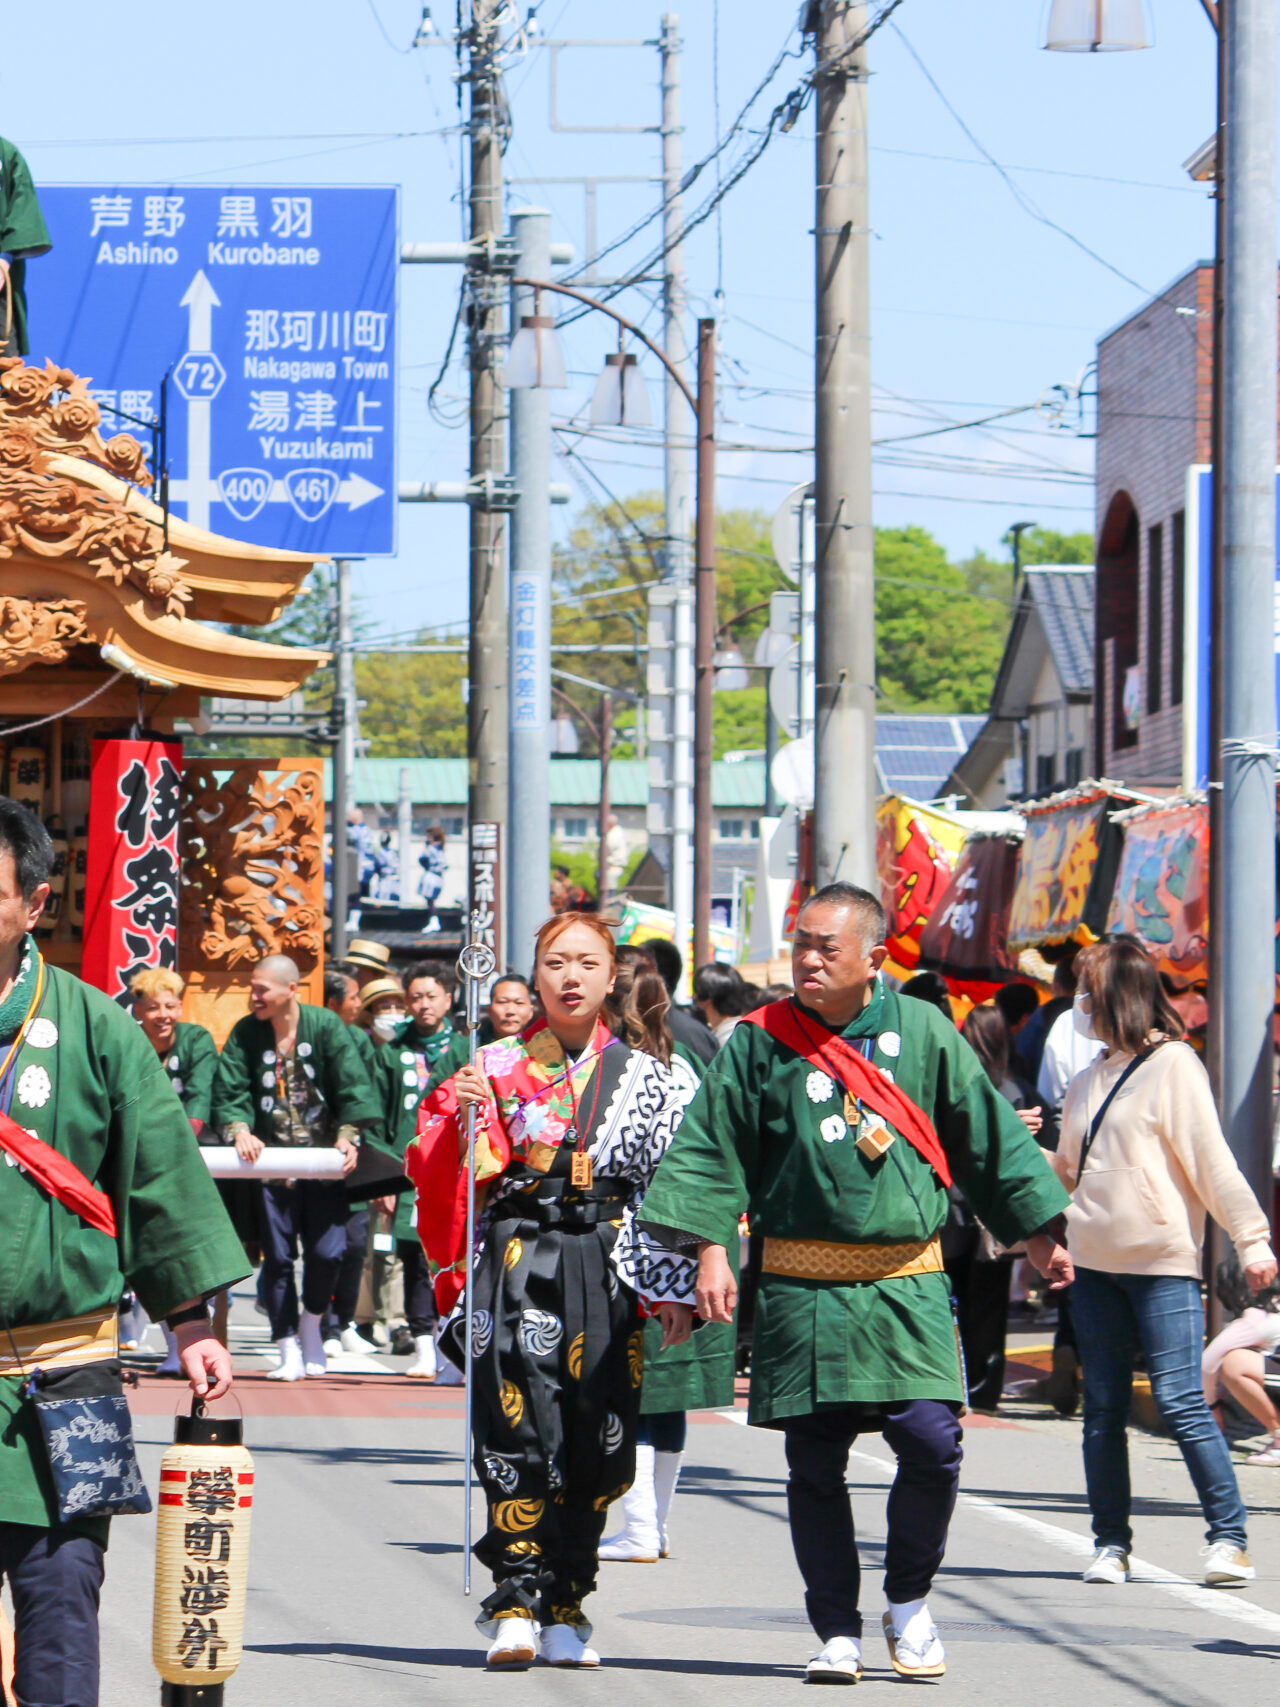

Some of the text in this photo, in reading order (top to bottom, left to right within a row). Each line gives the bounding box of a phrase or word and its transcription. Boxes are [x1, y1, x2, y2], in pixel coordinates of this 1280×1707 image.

[90, 196, 313, 238] 芦野 黒羽
[97, 242, 320, 265] Ashino Kurobane
[245, 310, 388, 352] 那珂川町
[185, 364, 215, 389] 72
[244, 357, 388, 381] Nakagawa Town
[248, 391, 384, 432] 湯津上
[260, 437, 373, 460] Yuzukami
[226, 477, 266, 501] 400
[295, 477, 330, 502] 461
